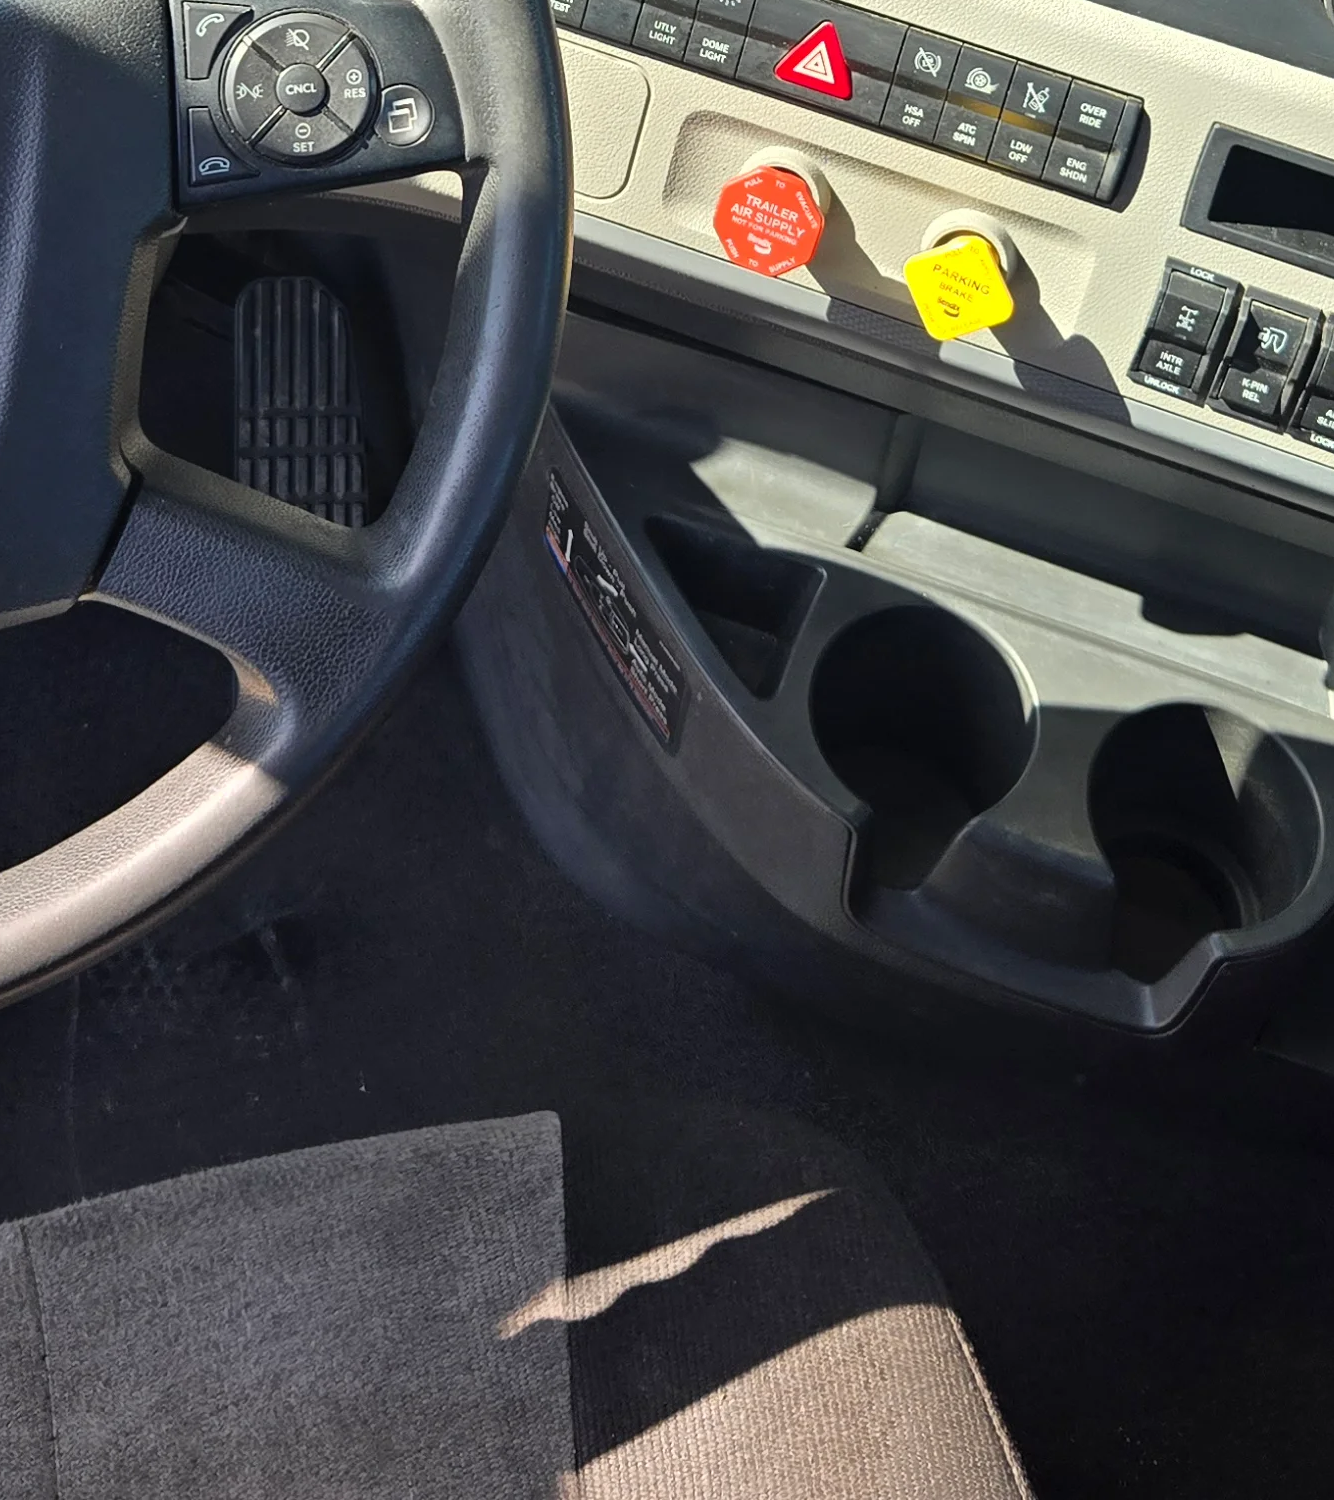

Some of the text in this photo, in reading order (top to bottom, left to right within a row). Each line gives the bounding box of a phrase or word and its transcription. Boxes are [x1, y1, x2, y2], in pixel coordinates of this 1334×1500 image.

[654, 20, 677, 35] UTLY
[649, 29, 676, 46] LIGHT
[702, 37, 730, 54] DOME
[699, 47, 727, 64] LIGHT
[285, 83, 317, 96] CNCL
[344, 88, 367, 99] RES
[904, 103, 924, 118] HSA
[1080, 101, 1108, 119] OVER
[902, 114, 921, 128] OFF
[957, 121, 977, 136] ATC
[1078, 113, 1103, 129] RIDE
[292, 141, 315, 153] SET
[952, 132, 976, 147] SPIN
[1010, 138, 1033, 154] LDW
[1008, 149, 1028, 164] OFF
[1066, 156, 1088, 171] ENG
[1059, 166, 1088, 184] SHDN
[744, 176, 818, 230] PULL TO EVACUATE
[746, 193, 799, 223] TRAILER
[730, 203, 806, 239] AIR SUPPLY
[731, 214, 798, 247] NOT FOR PARKING
[725, 238, 796, 274] PUSH TO SUPPLY
[932, 263, 991, 295] PARKING
[1190, 266, 1216, 282] LOCK
[939, 282, 975, 303] BRAKE
[1160, 350, 1184, 367] INTR
[1155, 360, 1182, 376] AXLE
[1144, 375, 1181, 395] UNLOCK
[1241, 378, 1269, 394] K-PIN
[1242, 388, 1261, 403] REL
